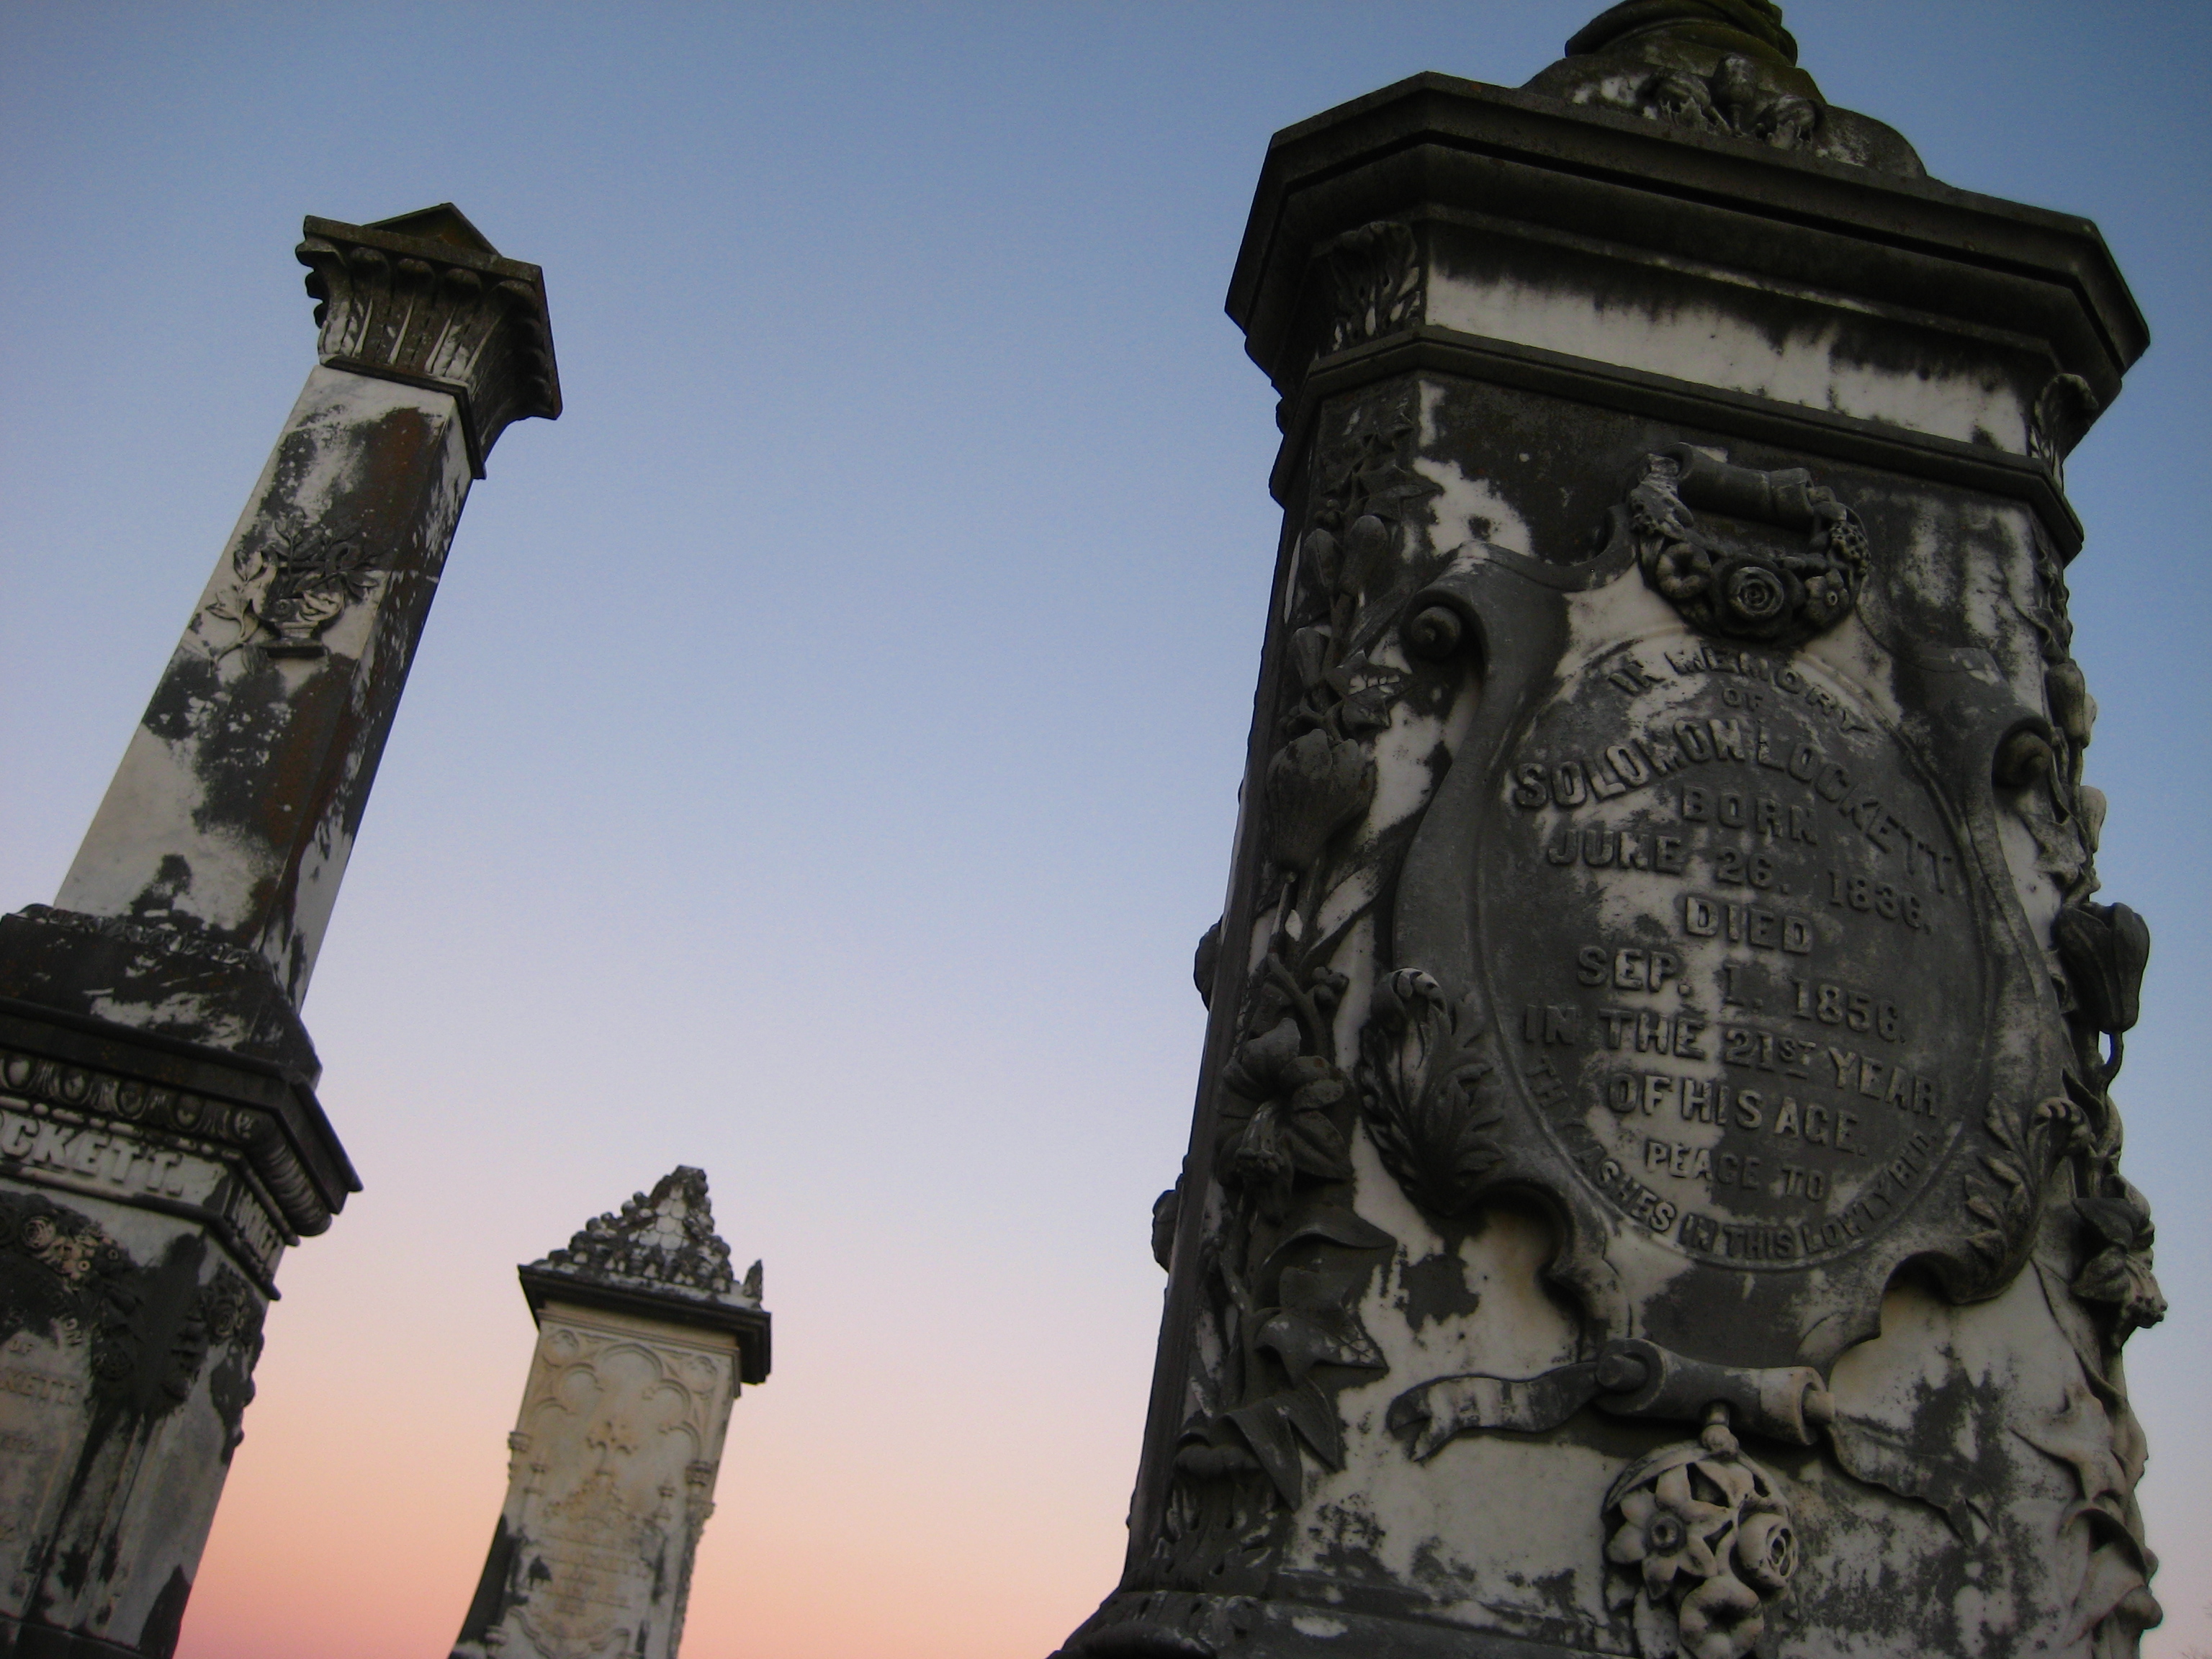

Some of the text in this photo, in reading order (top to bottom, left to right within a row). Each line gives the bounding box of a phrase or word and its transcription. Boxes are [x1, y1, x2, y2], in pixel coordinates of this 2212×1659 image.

[1609, 646, 1870, 734] IN MEMORY
[1722, 688, 1764, 712] OF
[1514, 719, 1953, 895] SOLOMON LOCKETT
[1681, 785, 1819, 845] BORN
[1548, 830, 1683, 875] JUNE
[1714, 847, 1791, 896] 26.
[1684, 894, 1815, 954] DIED
[1577, 945, 1692, 997] SEP.
[1524, 1004, 1577, 1046] IN
[1599, 1008, 1707, 1060] THE
[1827, 1046, 1938, 1117] YEAR
[1606, 1071, 1674, 1117] OF
[1679, 1076, 1763, 1129] HIS
[0, 1111, 184, 1198] CKETT.
[1645, 1138, 1827, 1202] PEACE TO
[1722, 1223, 1797, 1259] THIS
